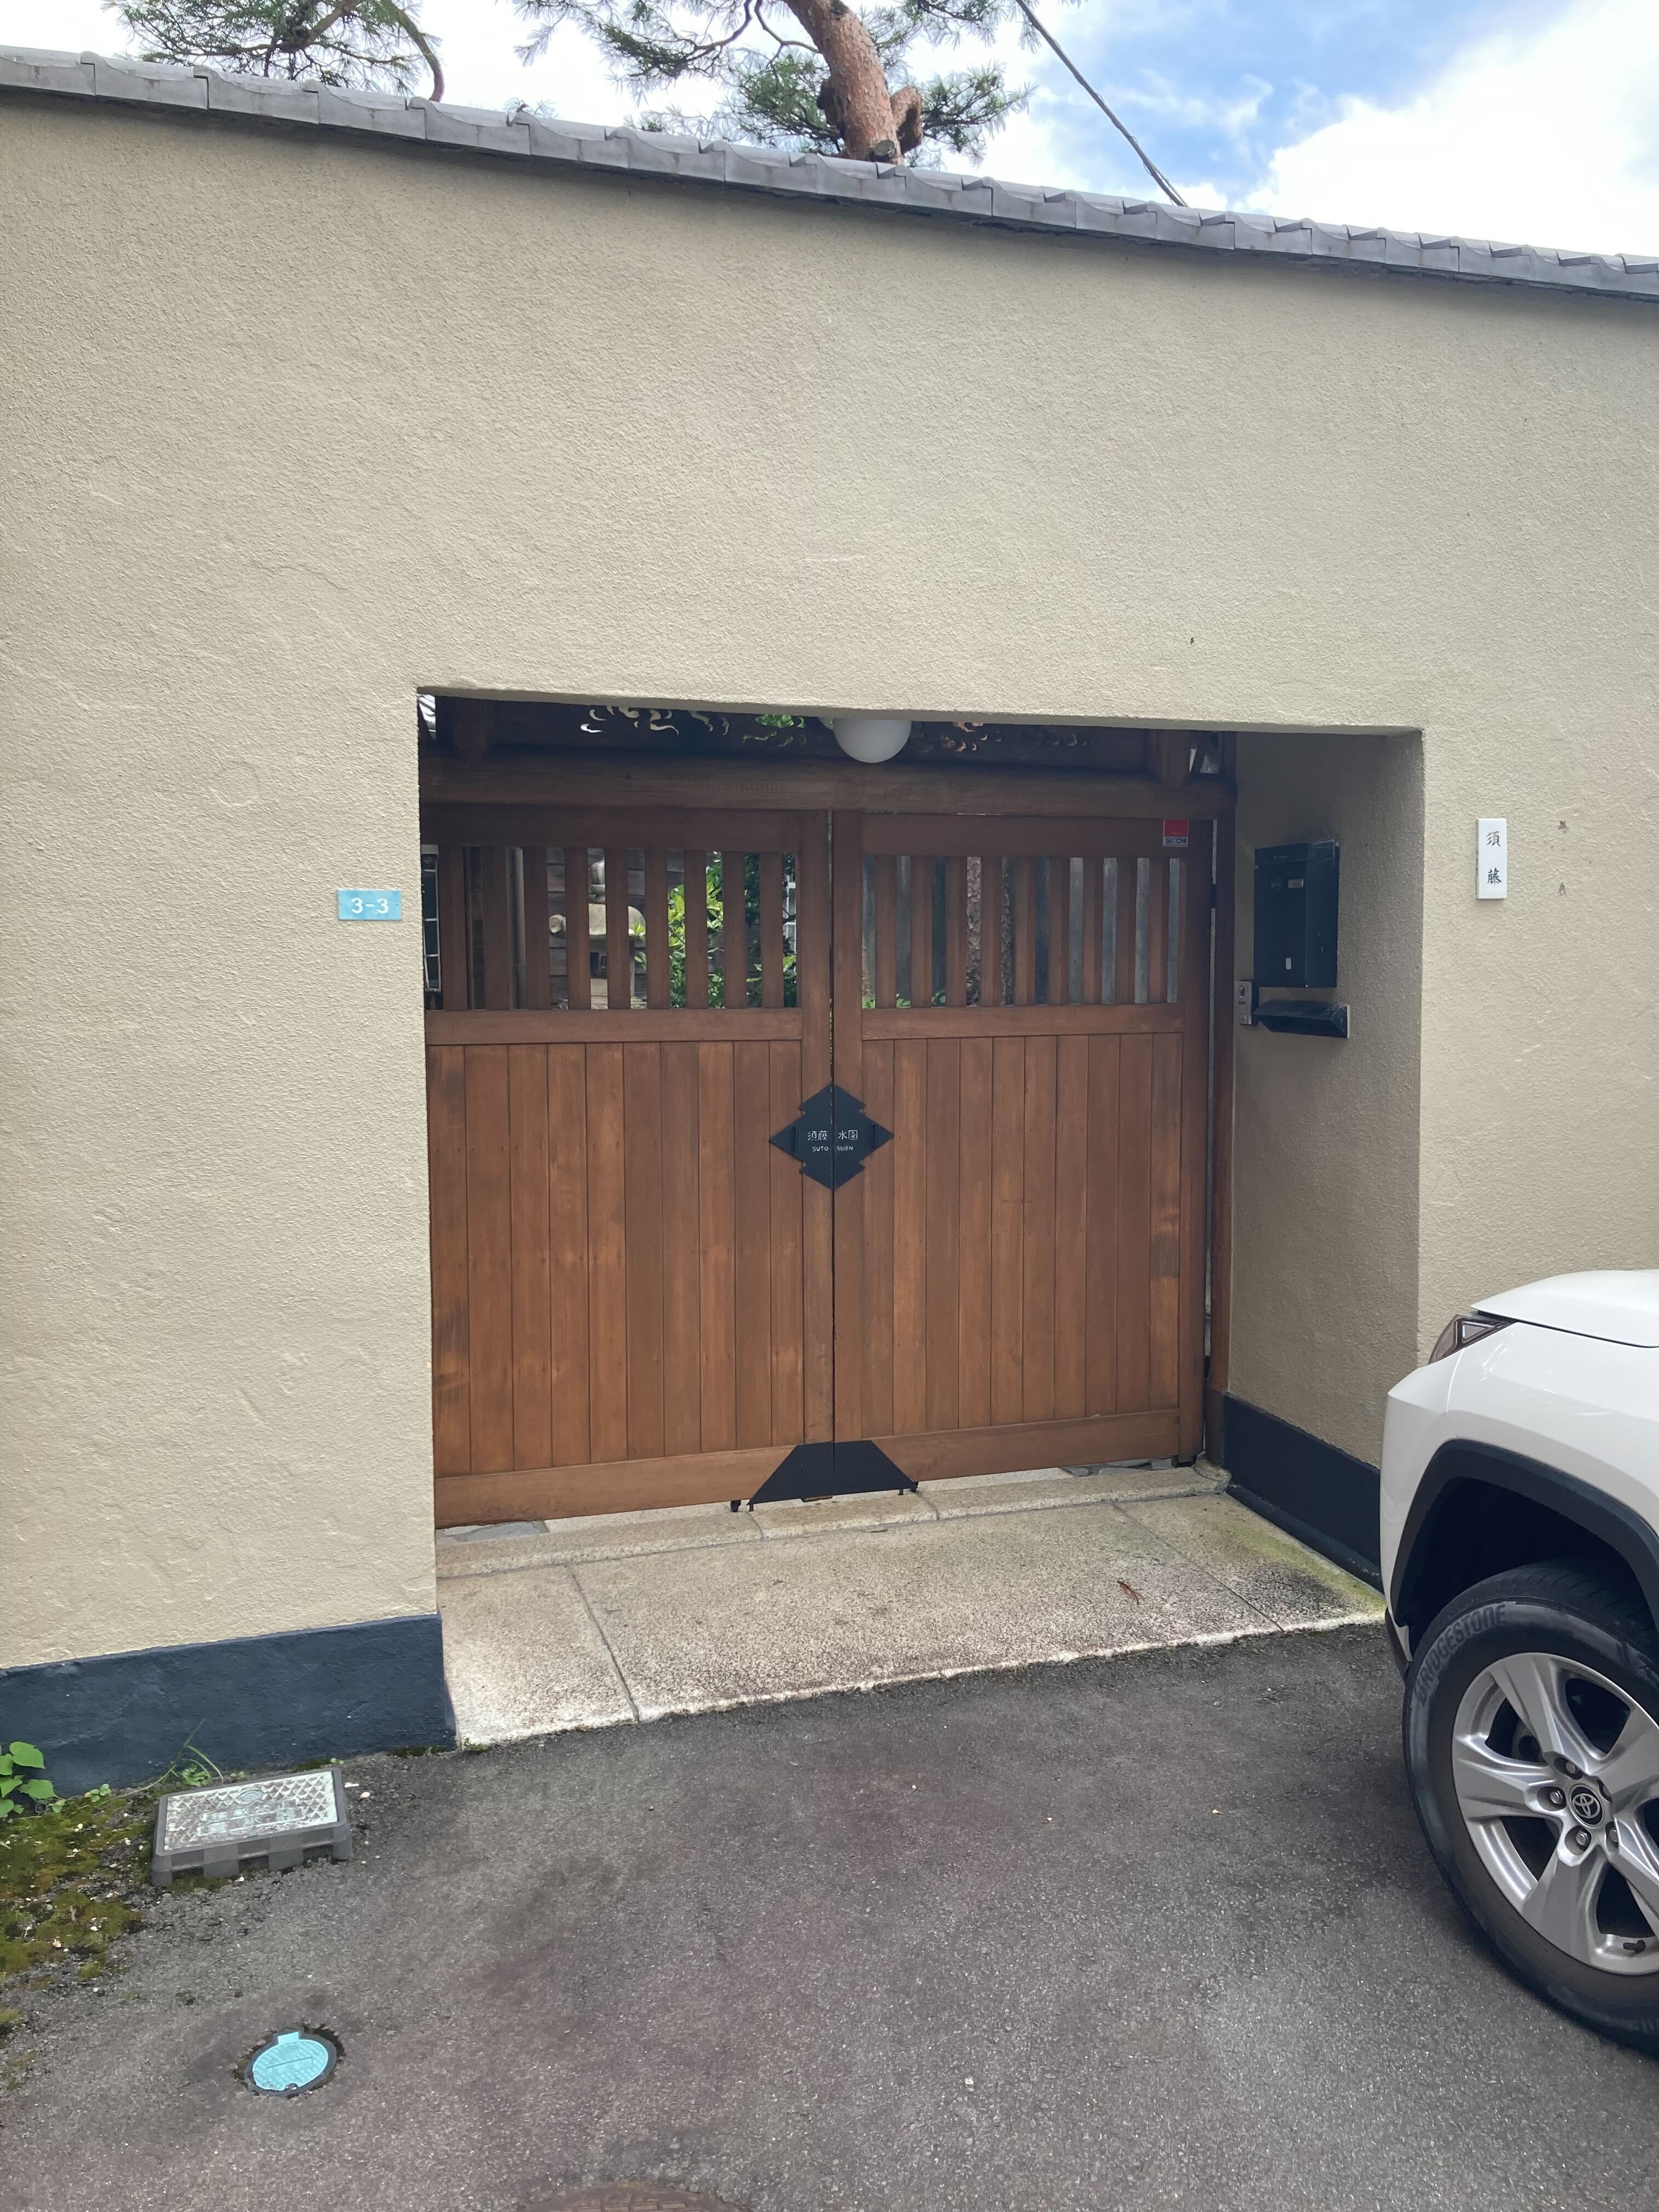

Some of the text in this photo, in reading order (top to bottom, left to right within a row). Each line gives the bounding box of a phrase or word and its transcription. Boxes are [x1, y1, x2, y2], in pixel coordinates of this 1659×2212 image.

[1486, 831, 1502, 885] 須藤
[351, 897, 389, 914] 3-3
[807, 1130, 828, 1141] 須藤
[1414, 1604, 1506, 1707] BRIDGESTONE
